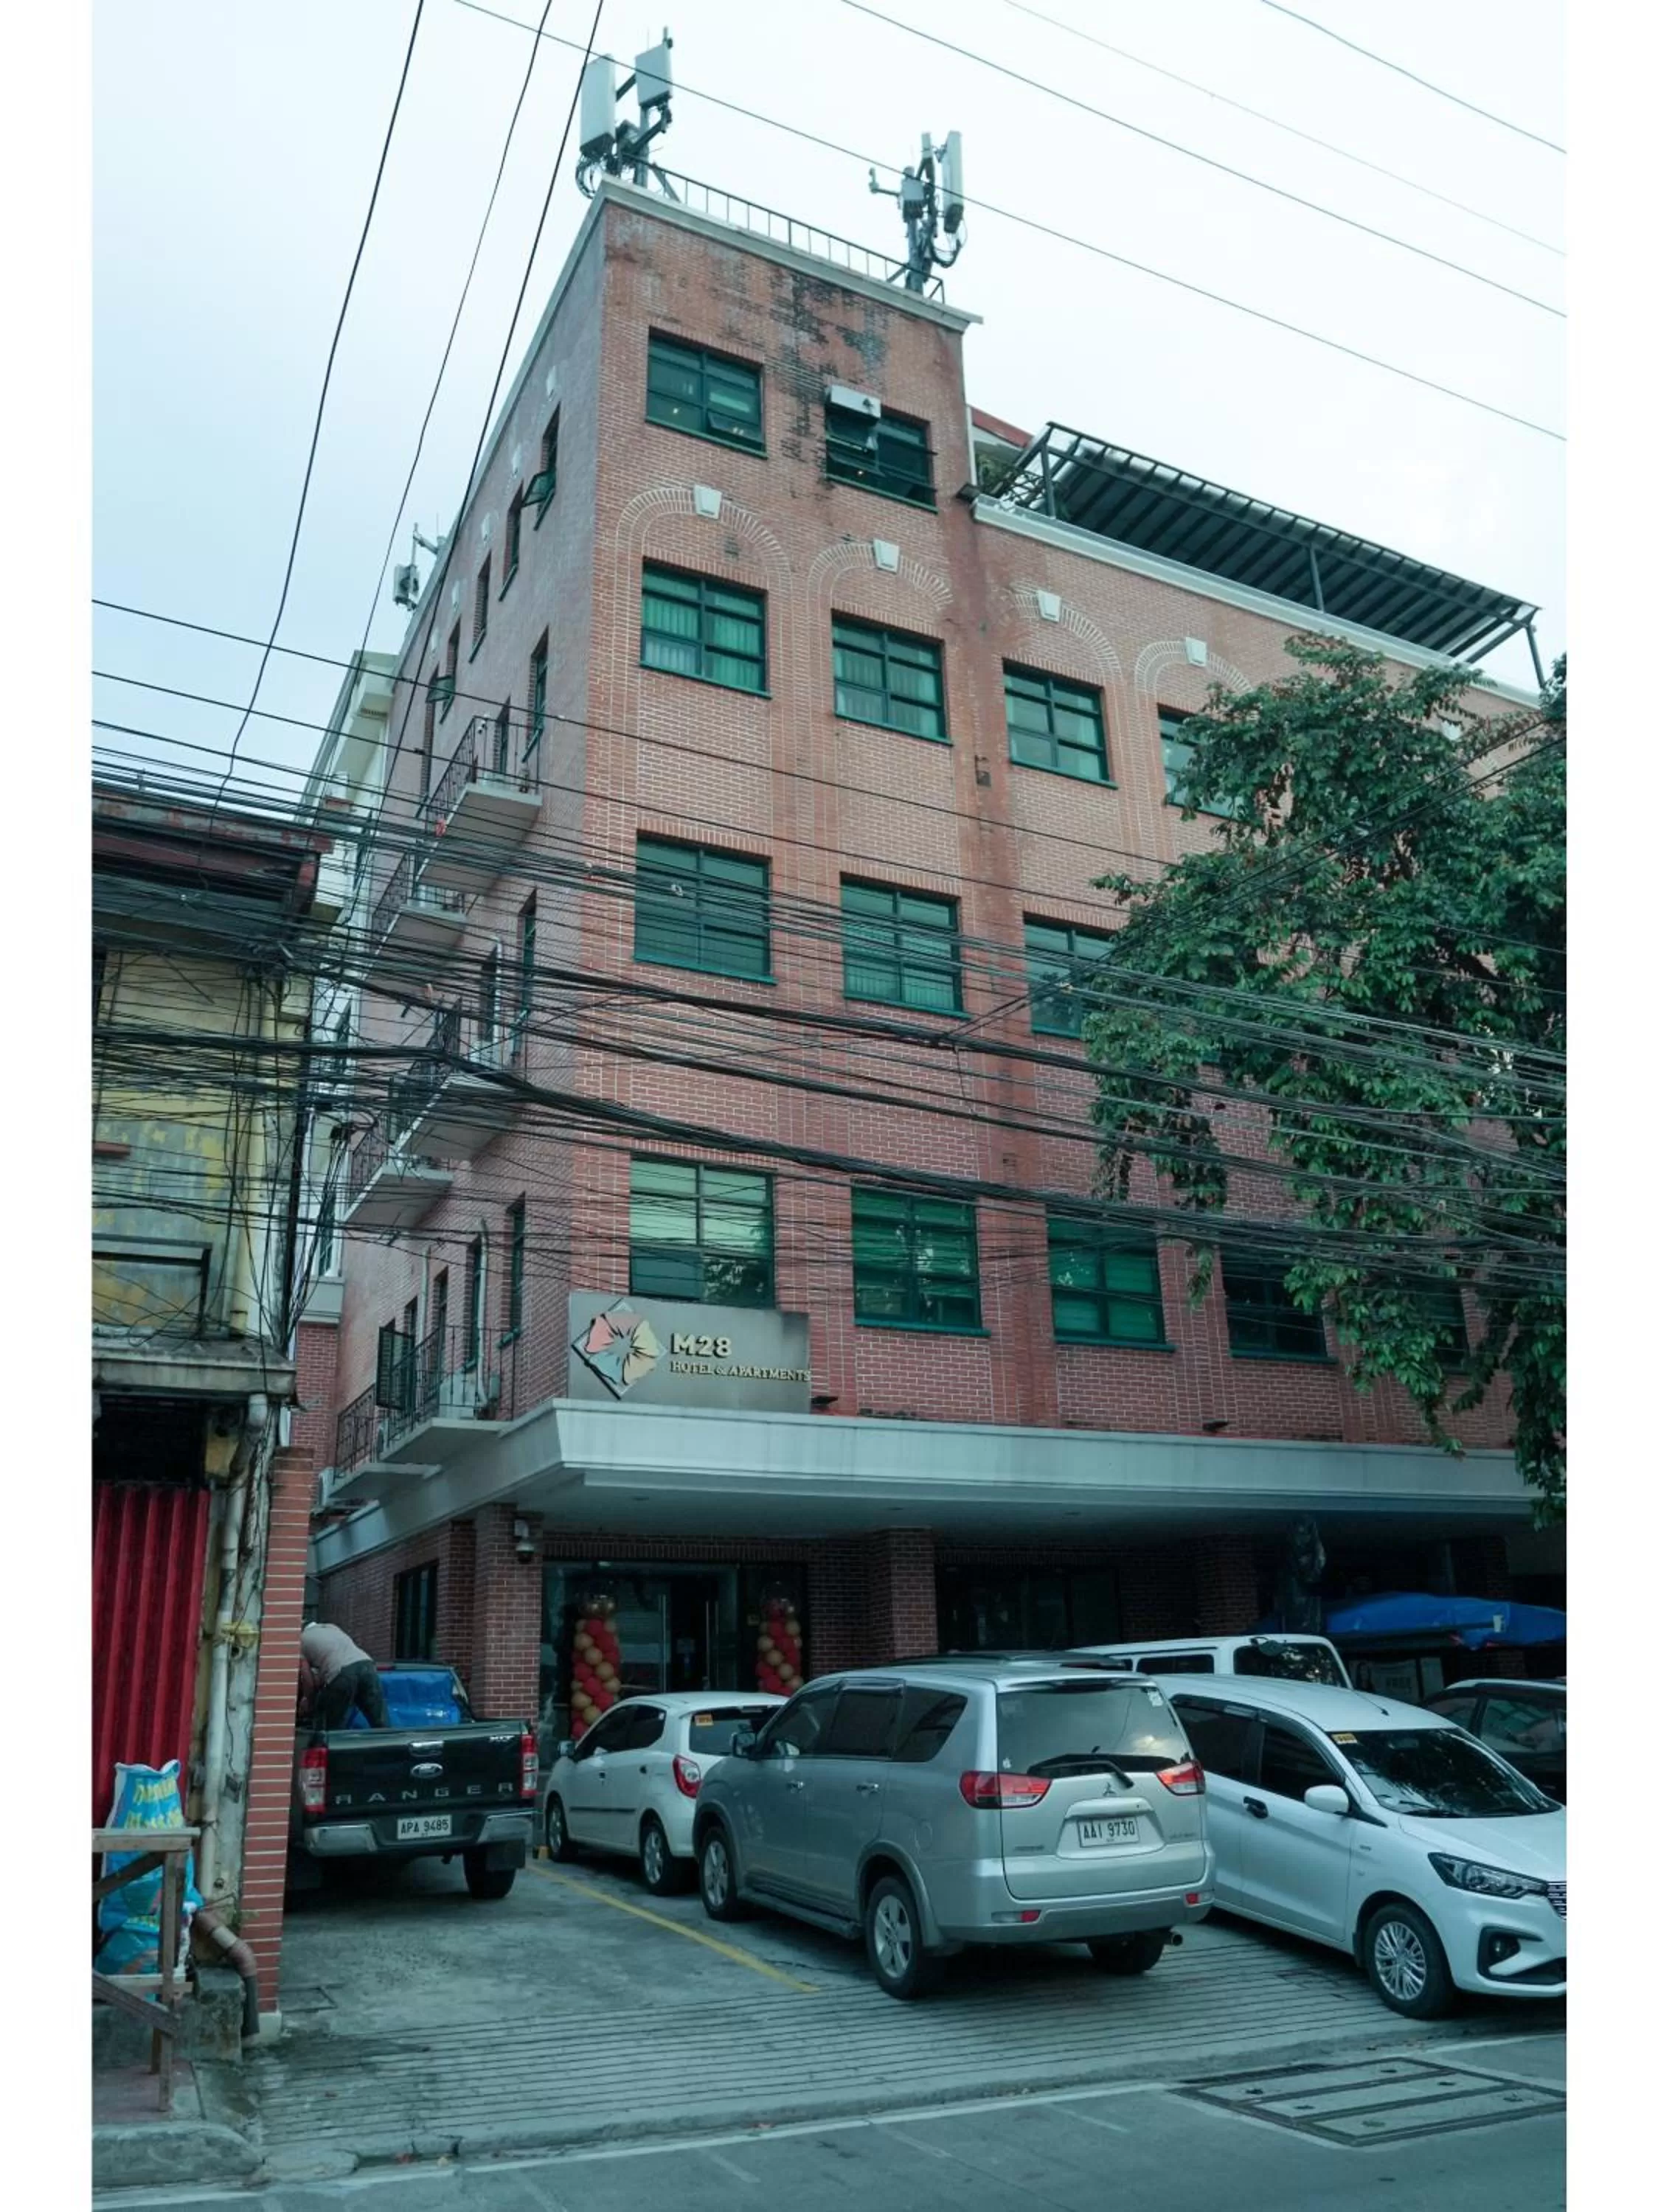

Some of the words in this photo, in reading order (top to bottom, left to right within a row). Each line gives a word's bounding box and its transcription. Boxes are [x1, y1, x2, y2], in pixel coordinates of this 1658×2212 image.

[671, 1332, 732, 1357] M28
[670, 1360, 713, 1374] HOTEL
[728, 1365, 811, 1382] APARTMENTS
[335, 1782, 513, 1805] RANGER
[401, 1821, 420, 1834] APA
[423, 1819, 449, 1832] 9485
[1107, 1820, 1135, 1837] 9730
